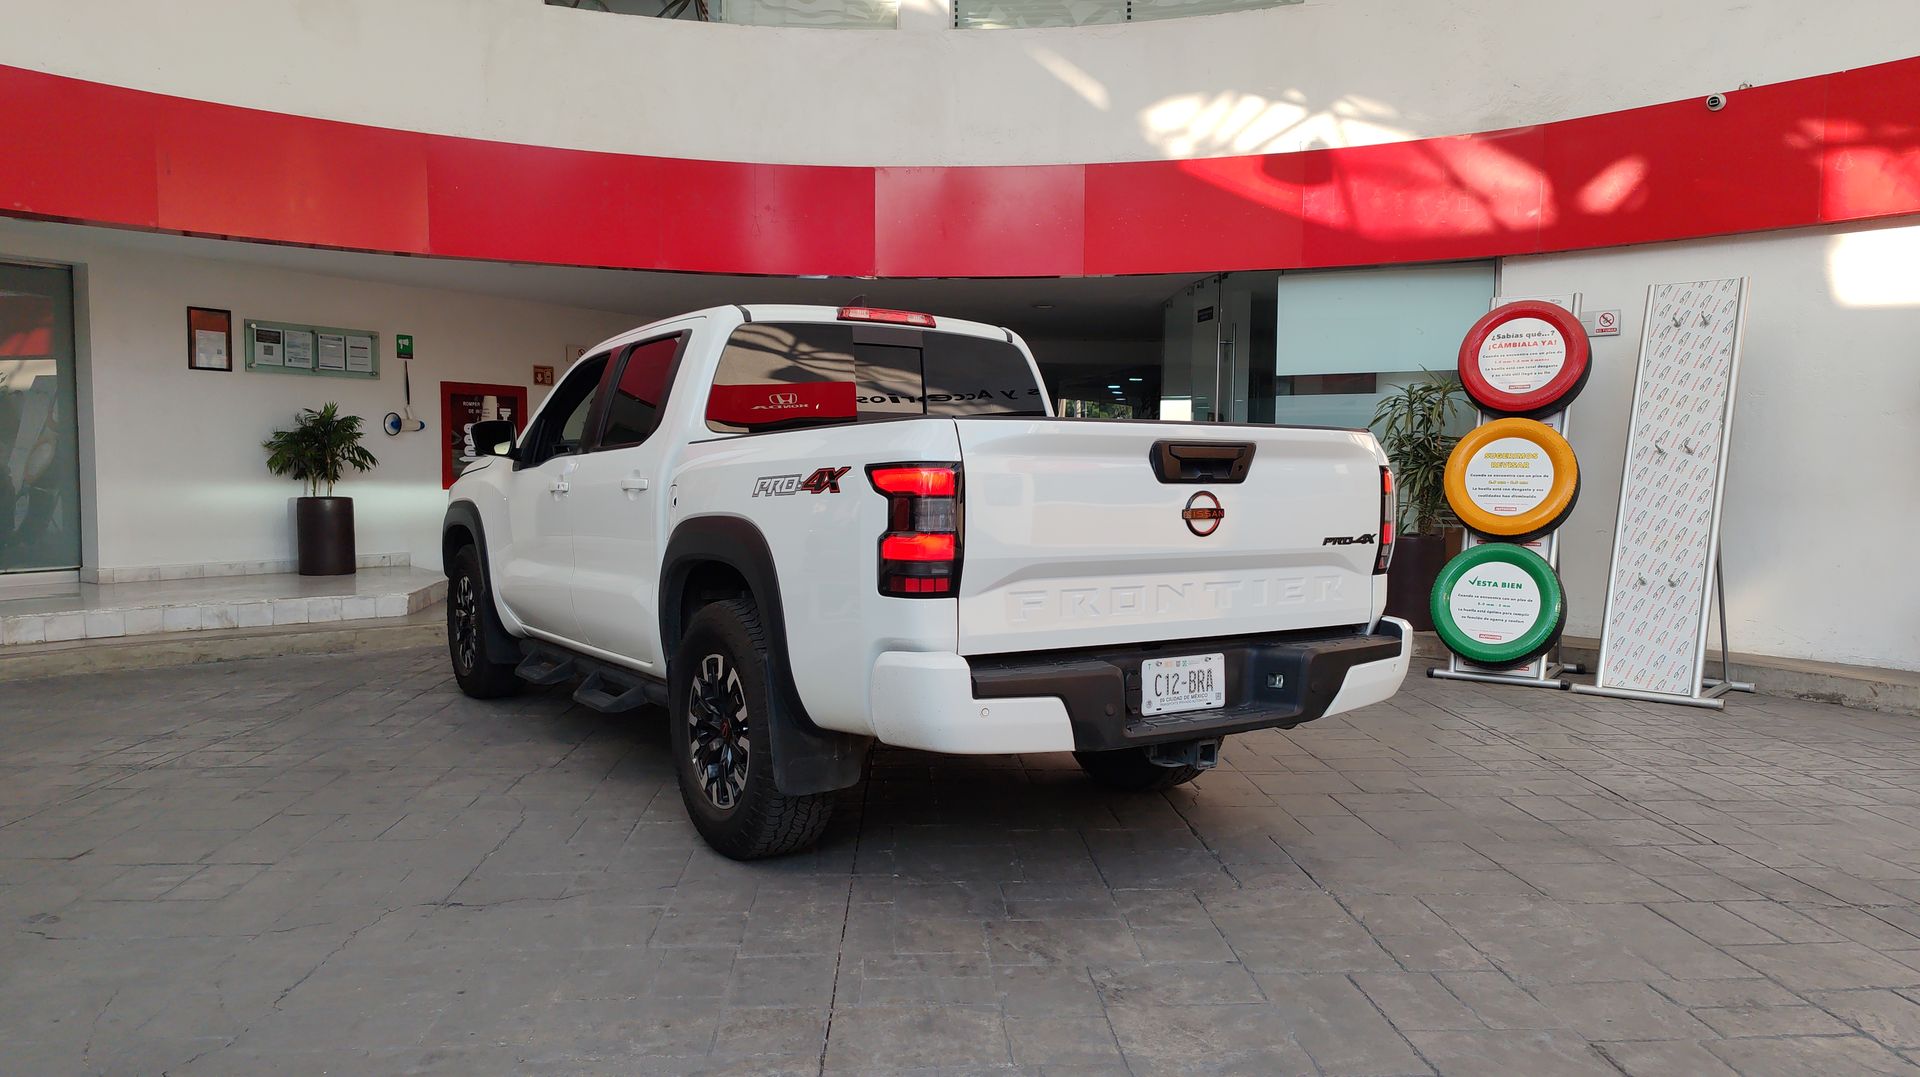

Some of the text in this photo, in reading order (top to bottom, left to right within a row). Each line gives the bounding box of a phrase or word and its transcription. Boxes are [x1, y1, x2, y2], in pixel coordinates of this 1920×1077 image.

[1183, 510, 1224, 518] NISSAN
[1501, 581, 1523, 589] BIEN
[1008, 575, 1345, 622] FRONTIER
[1155, 668, 1213, 697] C12-BRA
